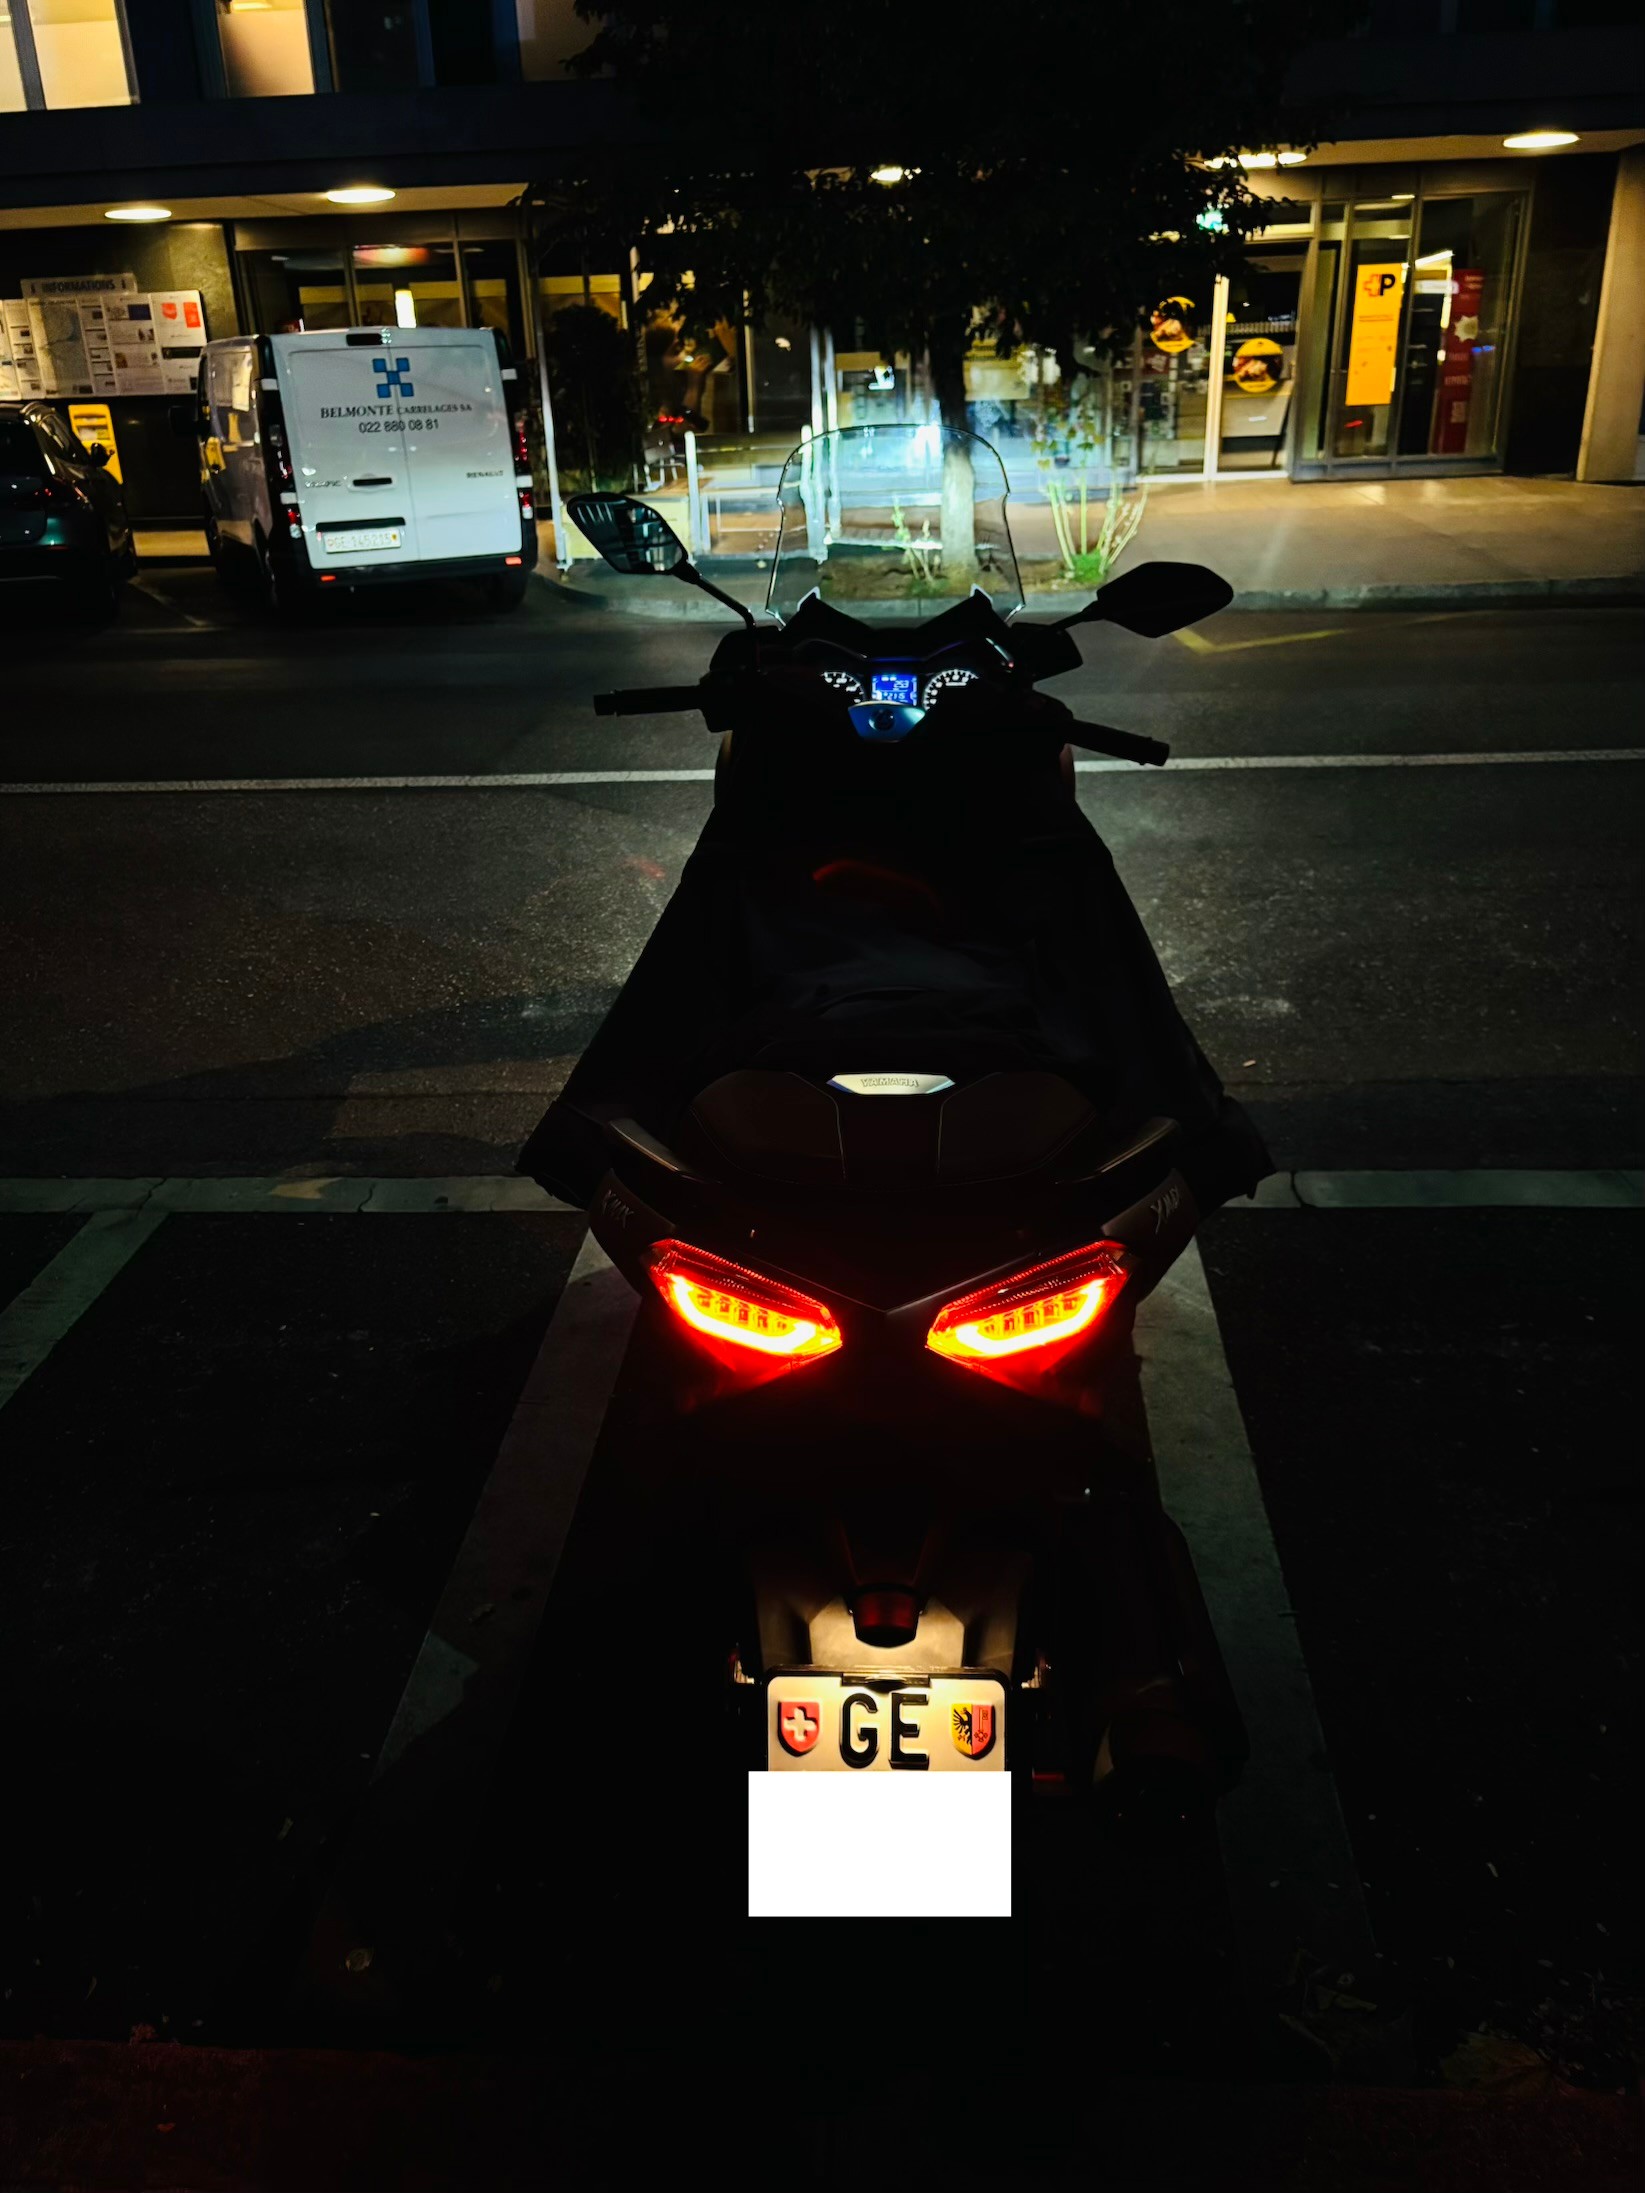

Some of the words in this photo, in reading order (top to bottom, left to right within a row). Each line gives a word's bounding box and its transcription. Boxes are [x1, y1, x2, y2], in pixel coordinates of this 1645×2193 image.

[42, 279, 116, 293] INFORMATIONS
[1379, 273, 1396, 297] P
[320, 405, 393, 419] BELMONTE
[358, 421, 382, 434] 022
[408, 419, 423, 431] 08
[425, 418, 439, 431] 81
[860, 1077, 920, 1088] YAMAHA
[839, 1691, 930, 1771] GE
